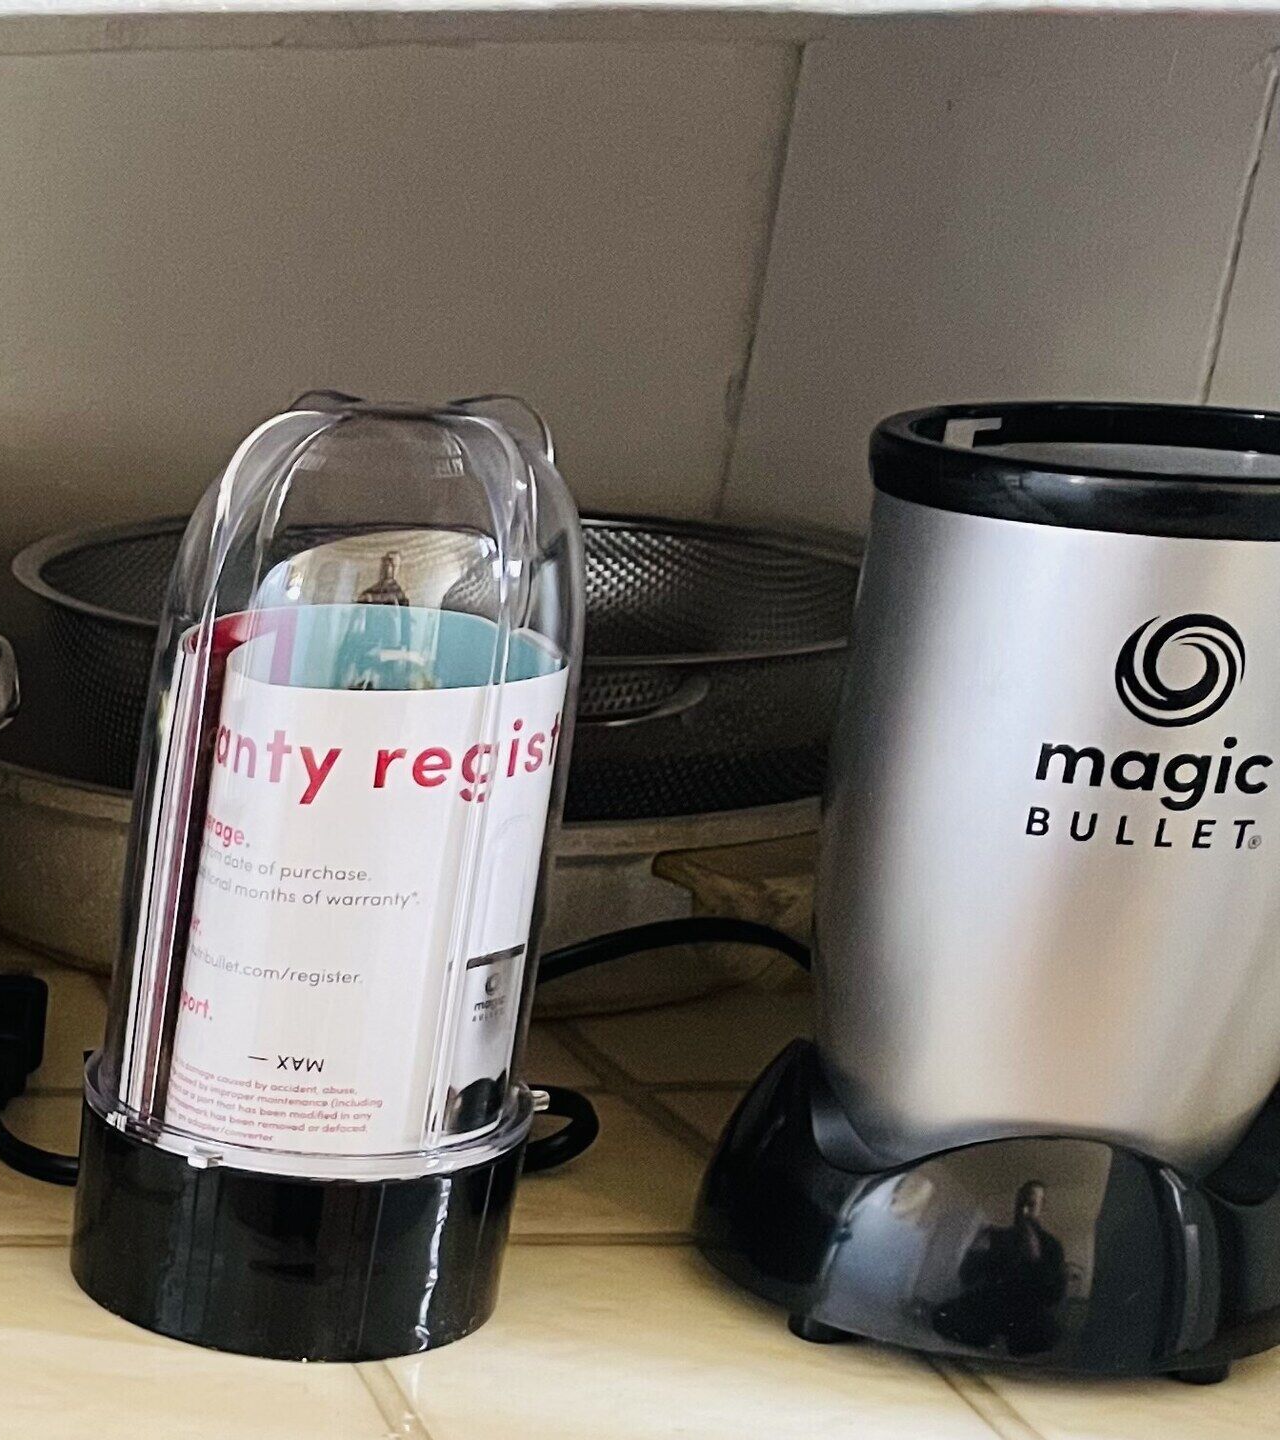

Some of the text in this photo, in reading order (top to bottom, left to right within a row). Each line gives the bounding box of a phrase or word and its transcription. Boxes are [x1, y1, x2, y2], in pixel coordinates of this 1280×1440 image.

[1035, 736, 1274, 811] magic
[224, 853, 253, 872] date
[258, 860, 277, 877] of
[279, 865, 373, 882] purchase.
[234, 882, 296, 904] months
[302, 890, 322, 906] of
[276, 1054, 325, 1073] MAX
[254, 1080, 268, 1092] by
[321, 1085, 359, 1096] abuse,
[257, 1095, 329, 1107] maintenance
[330, 1097, 384, 1109] (including
[289, 1109, 338, 1120] modified
[340, 1111, 351, 1120] in
[352, 1112, 372, 1121] any
